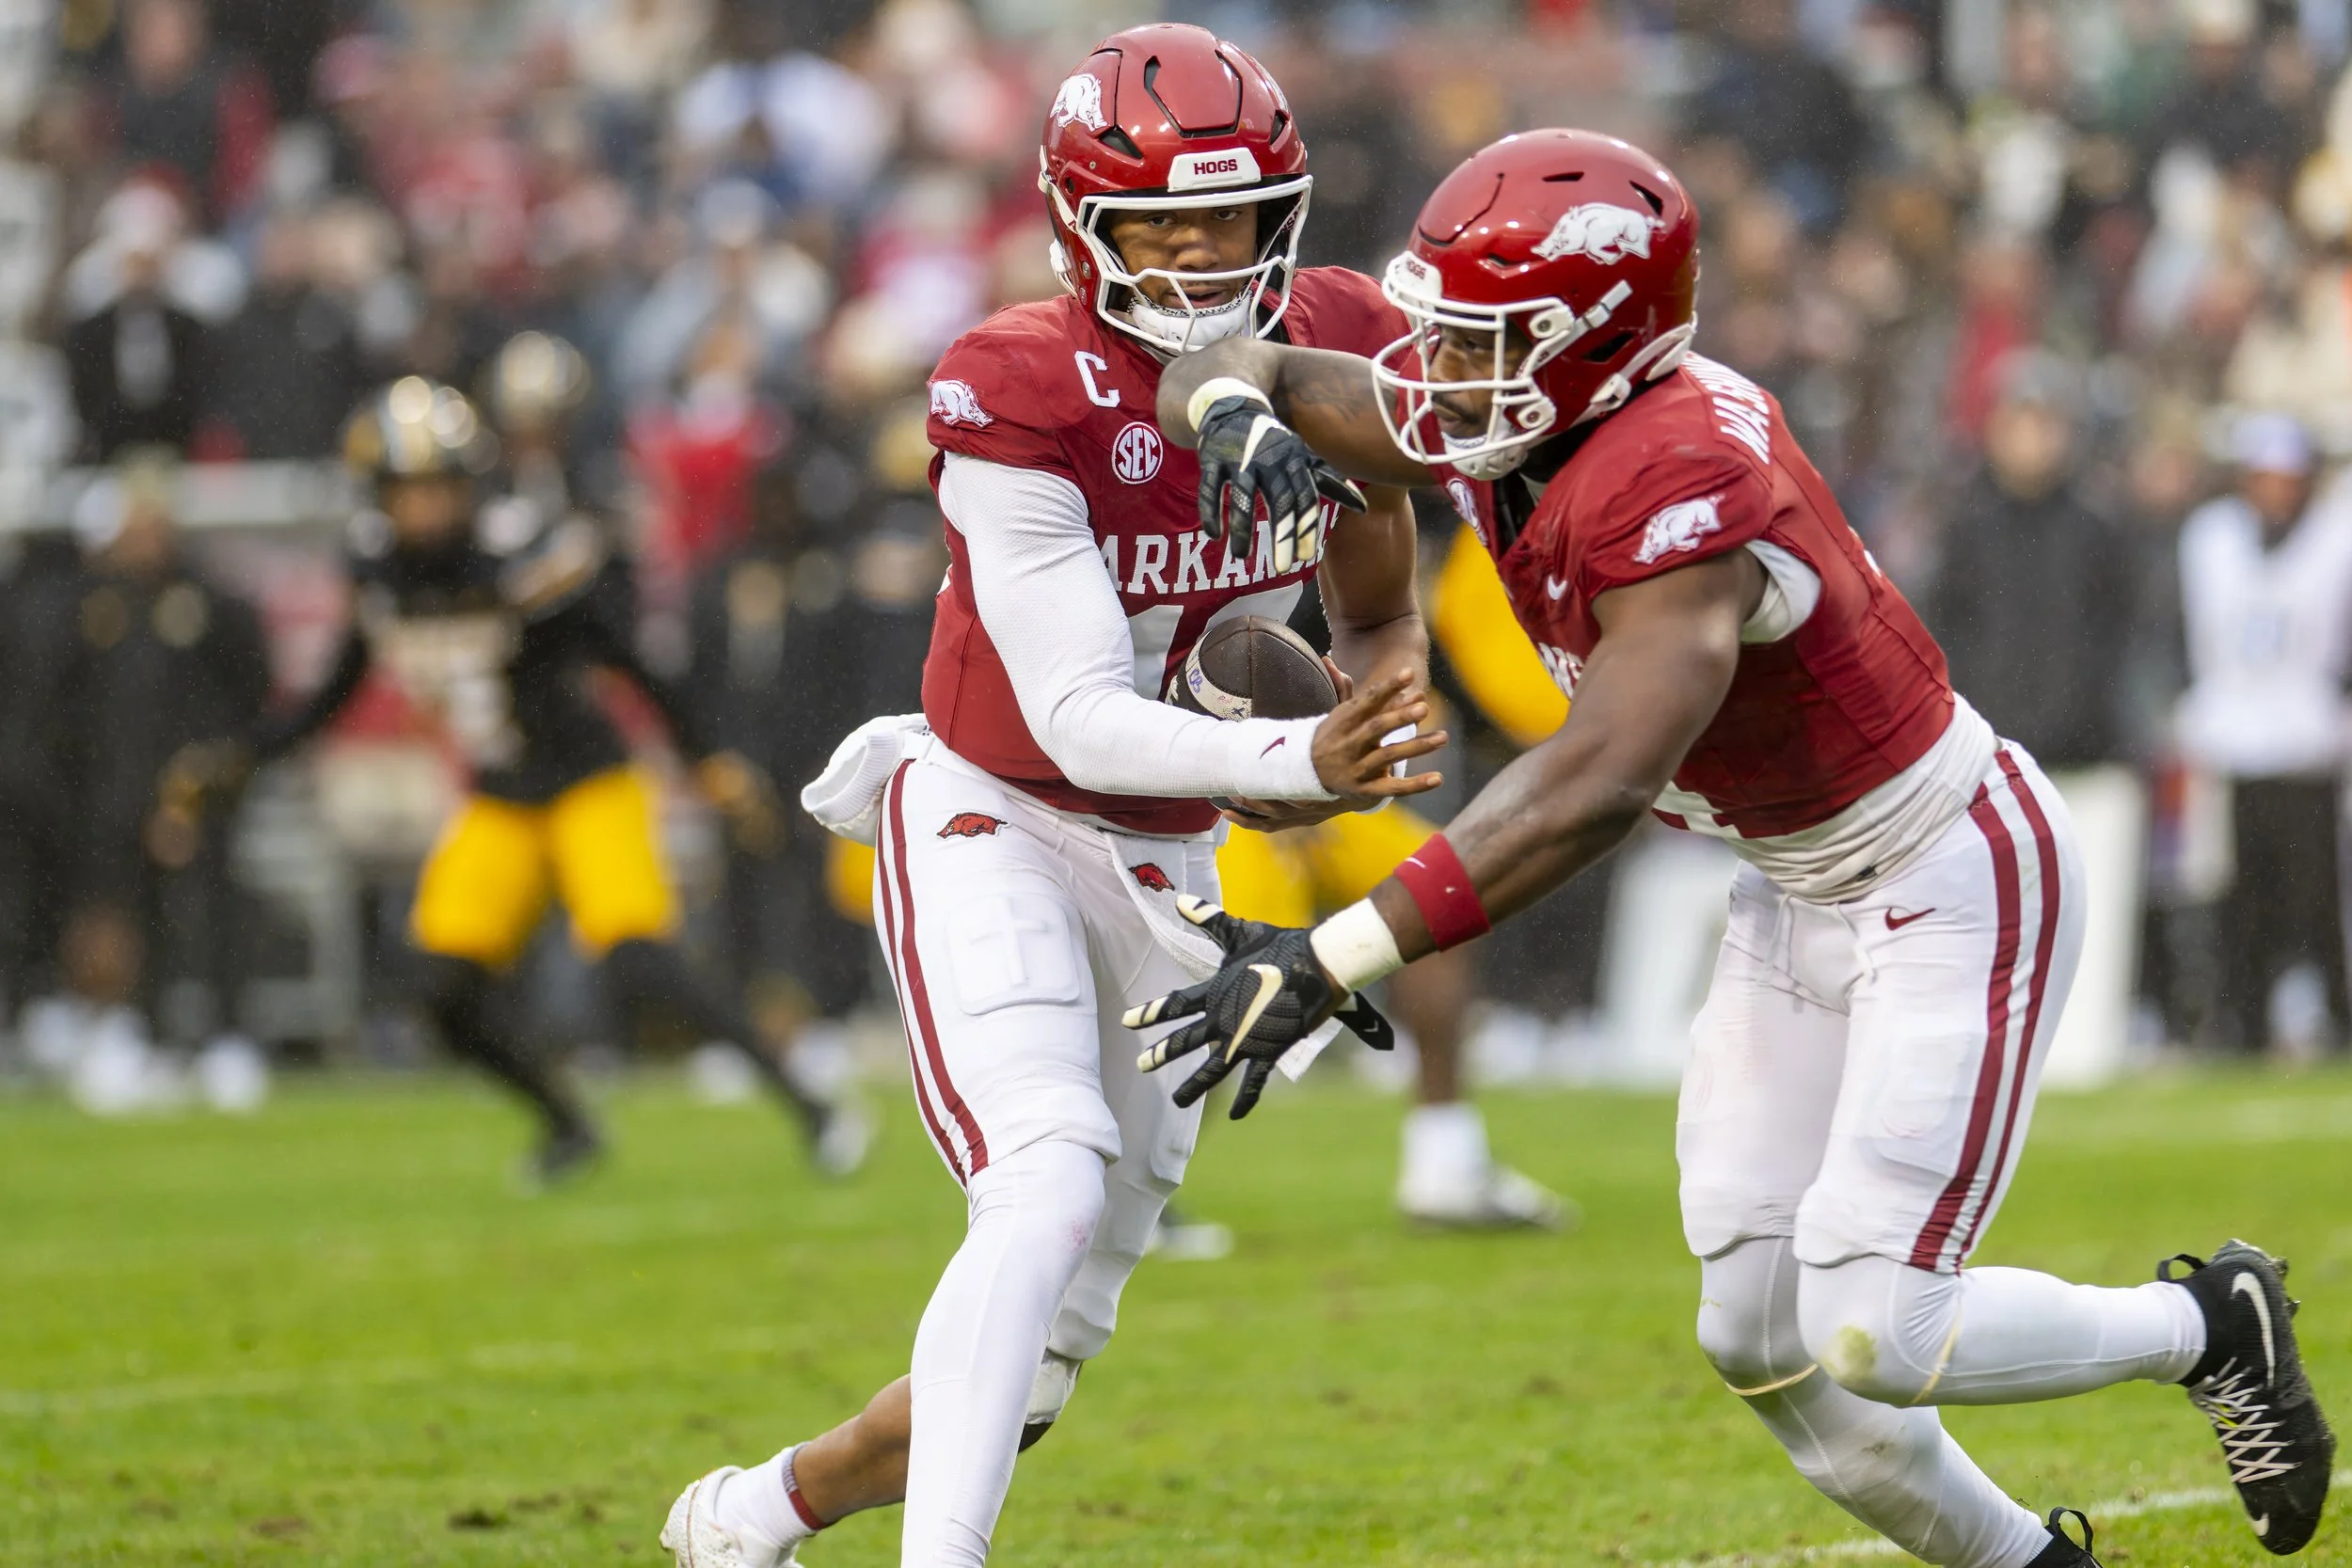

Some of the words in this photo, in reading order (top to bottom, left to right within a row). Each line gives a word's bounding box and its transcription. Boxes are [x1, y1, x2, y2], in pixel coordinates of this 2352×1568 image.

[1193, 158, 1239, 176] HOGS
[1074, 350, 1121, 408] C
[1118, 427, 1158, 480] SEC
